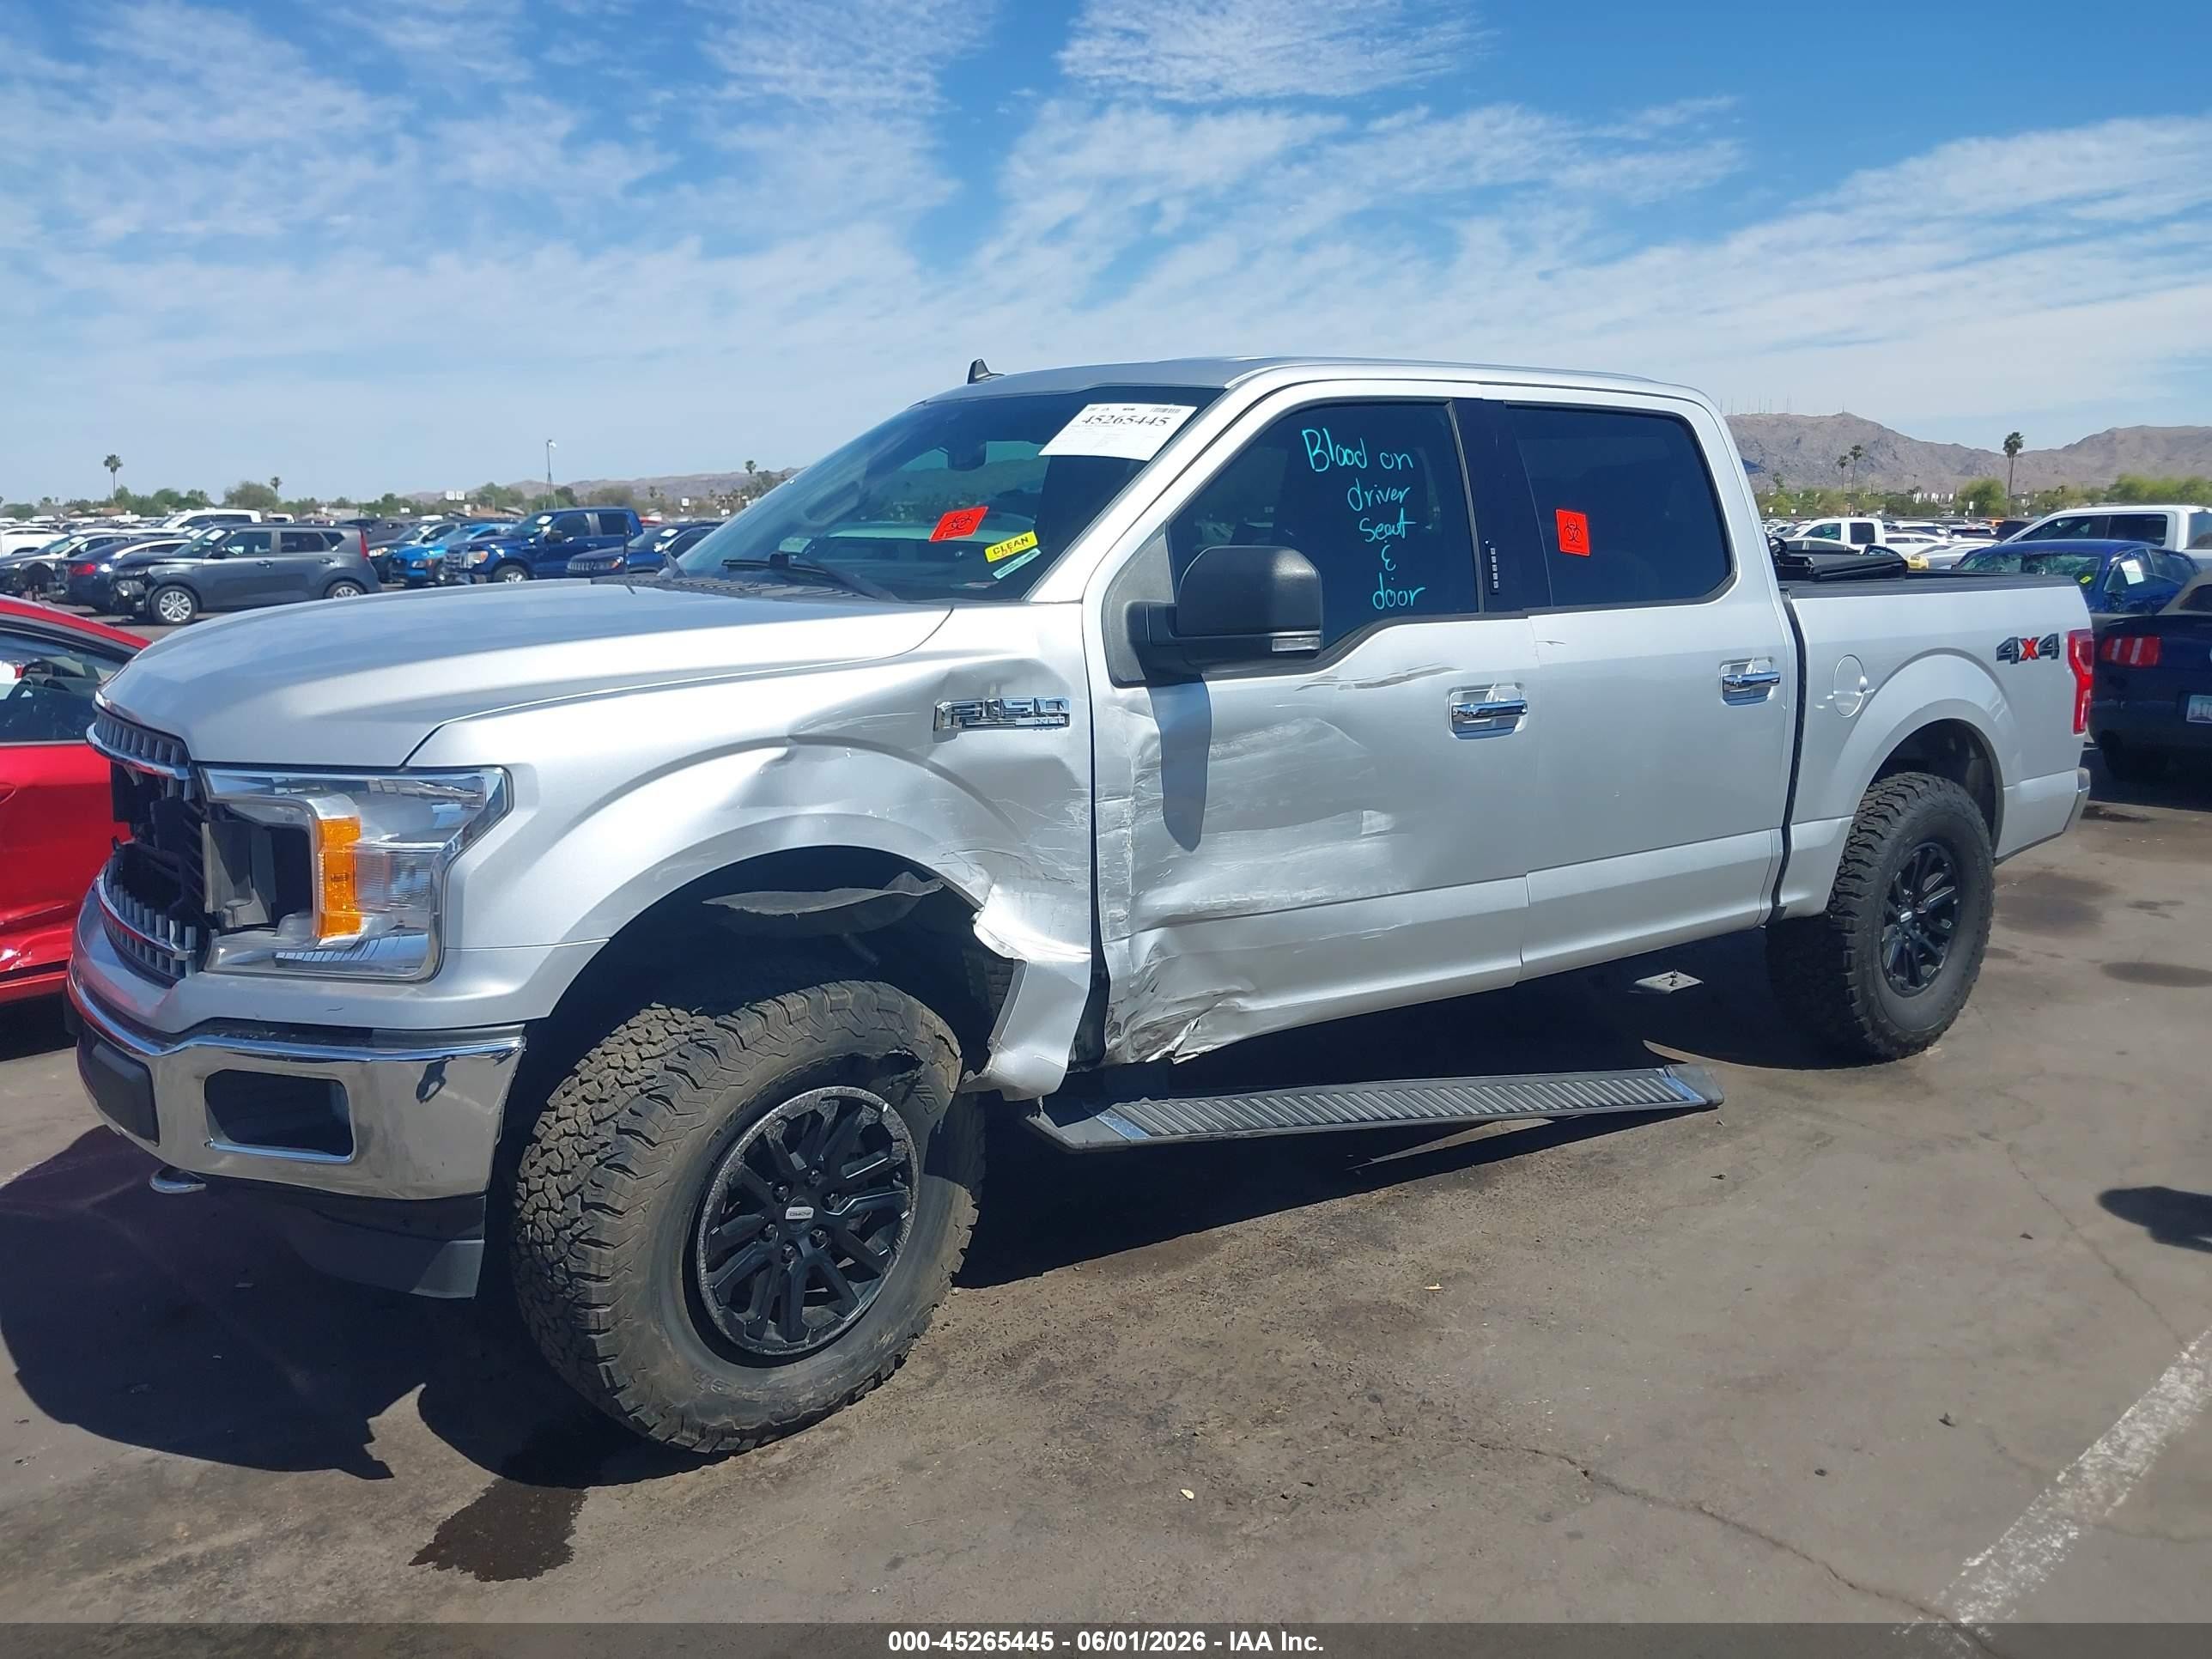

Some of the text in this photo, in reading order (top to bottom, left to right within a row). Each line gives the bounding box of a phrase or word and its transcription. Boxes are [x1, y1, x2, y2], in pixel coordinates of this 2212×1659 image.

[1082, 415, 1170, 427] 45265445
[1302, 428, 1413, 471] Blood on
[1347, 477, 1410, 511] driver
[993, 537, 1029, 555] CLEAN
[1373, 573, 1425, 610] door
